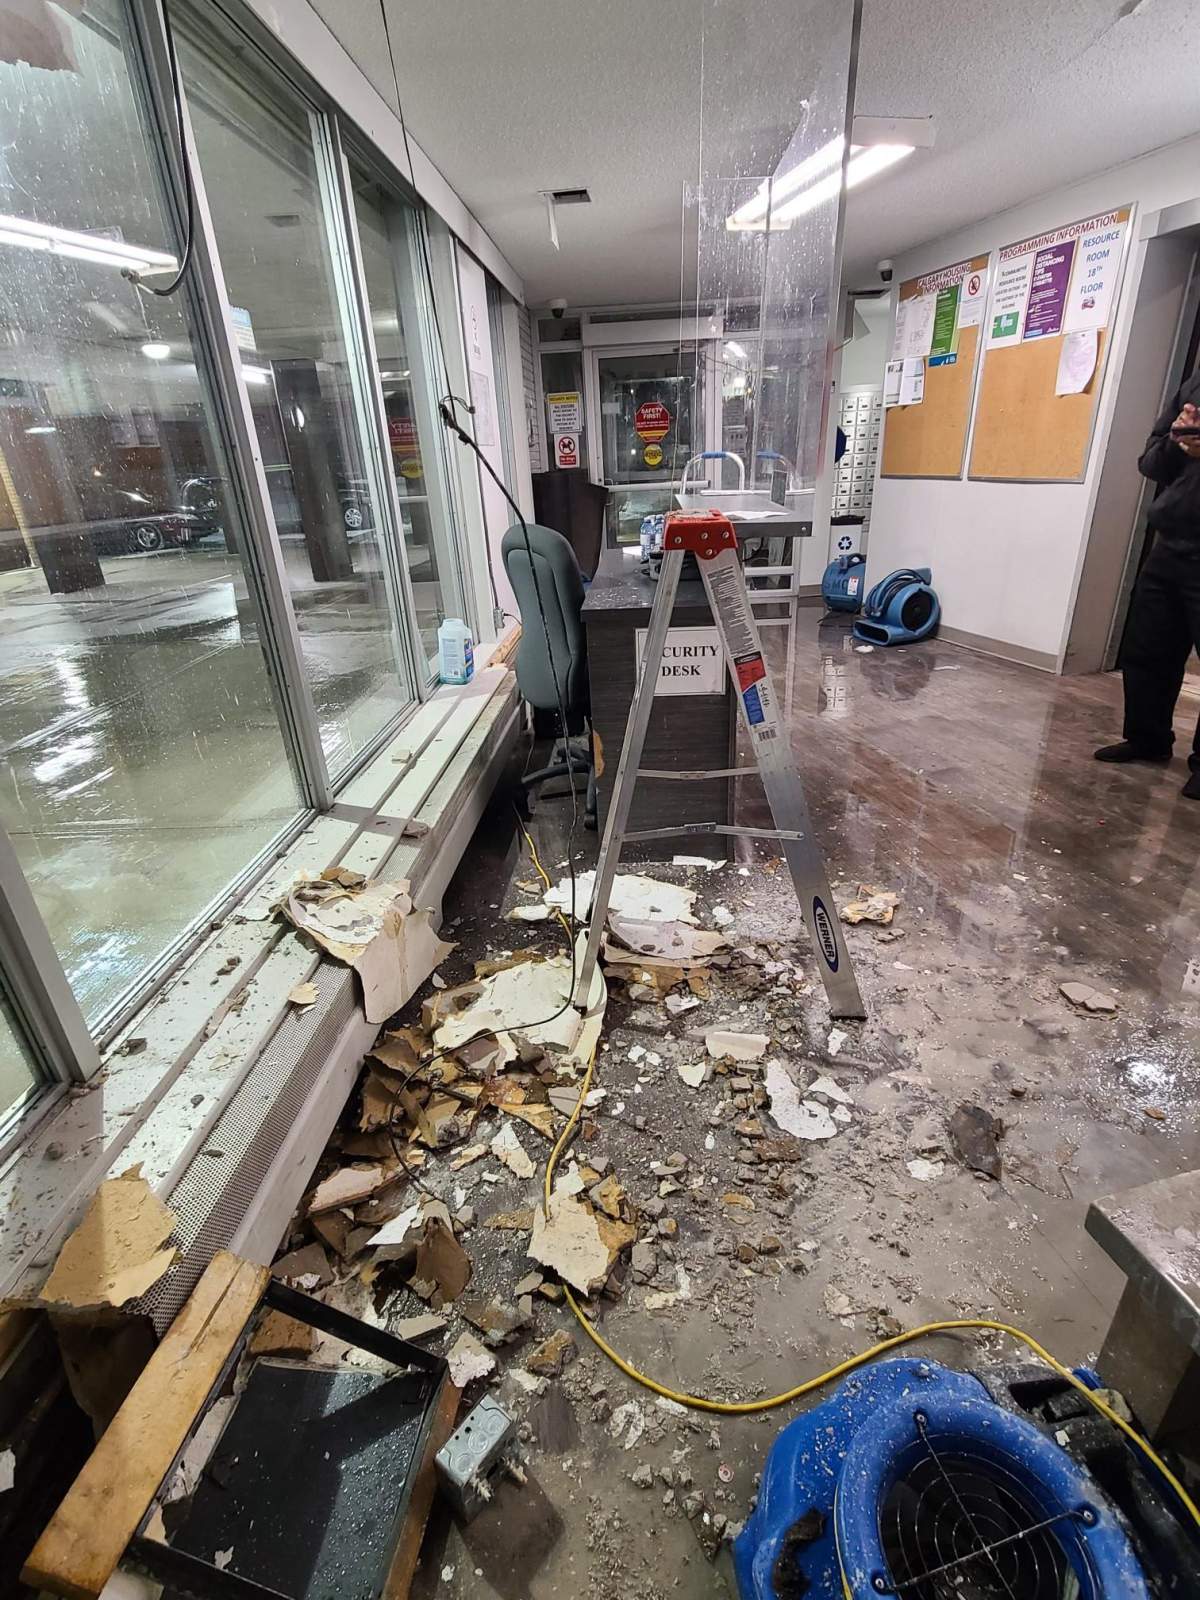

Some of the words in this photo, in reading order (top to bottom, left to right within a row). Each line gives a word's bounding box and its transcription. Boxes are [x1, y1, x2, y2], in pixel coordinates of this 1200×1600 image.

[999, 235, 1056, 260] PROGRAMMING
[1055, 214, 1118, 240] INFORMATION
[1082, 230, 1120, 248] RESOURCE
[1086, 249, 1110, 263] ROOM
[919, 274, 944, 289] CALGARY
[943, 263, 972, 280] HOUSING
[924, 275, 964, 294] INFORMATION
[1080, 281, 1104, 295] FLOOR
[662, 645, 719, 658] CURITY
[662, 665, 701, 677] DESK
[816, 912, 835, 958] WERNER
